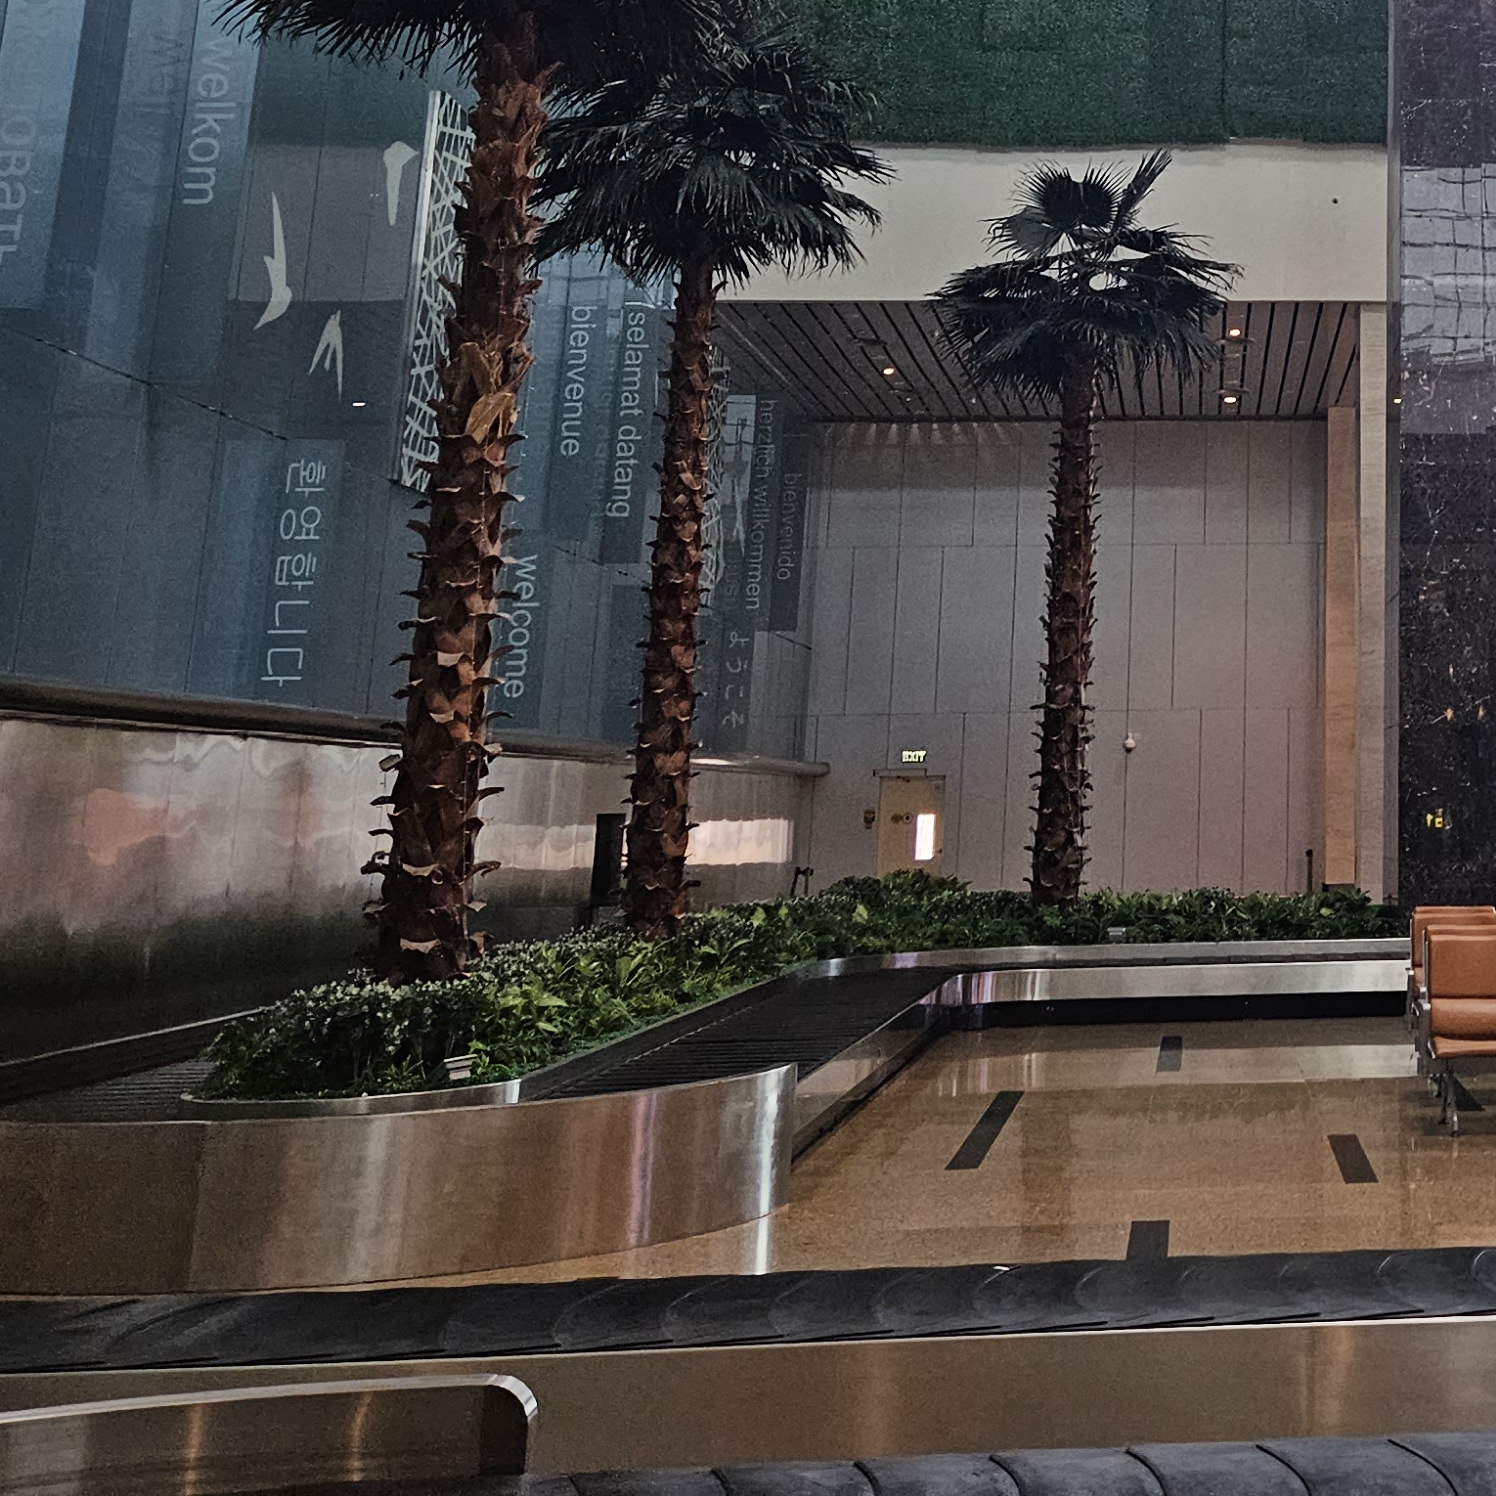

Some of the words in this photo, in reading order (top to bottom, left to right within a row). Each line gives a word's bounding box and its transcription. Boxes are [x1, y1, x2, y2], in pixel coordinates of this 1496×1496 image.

[182, 40, 236, 206] welkom
[559, 305, 599, 458] bienvenue
[618, 310, 649, 421] selamat
[605, 423, 642, 518] datang
[756, 399, 779, 483] herzlich
[261, 458, 327, 688] 환영합니다
[775, 473, 803, 581] bienvenido
[722, 633, 751, 728] ようこそ
[902, 750, 927, 762] EXIT
